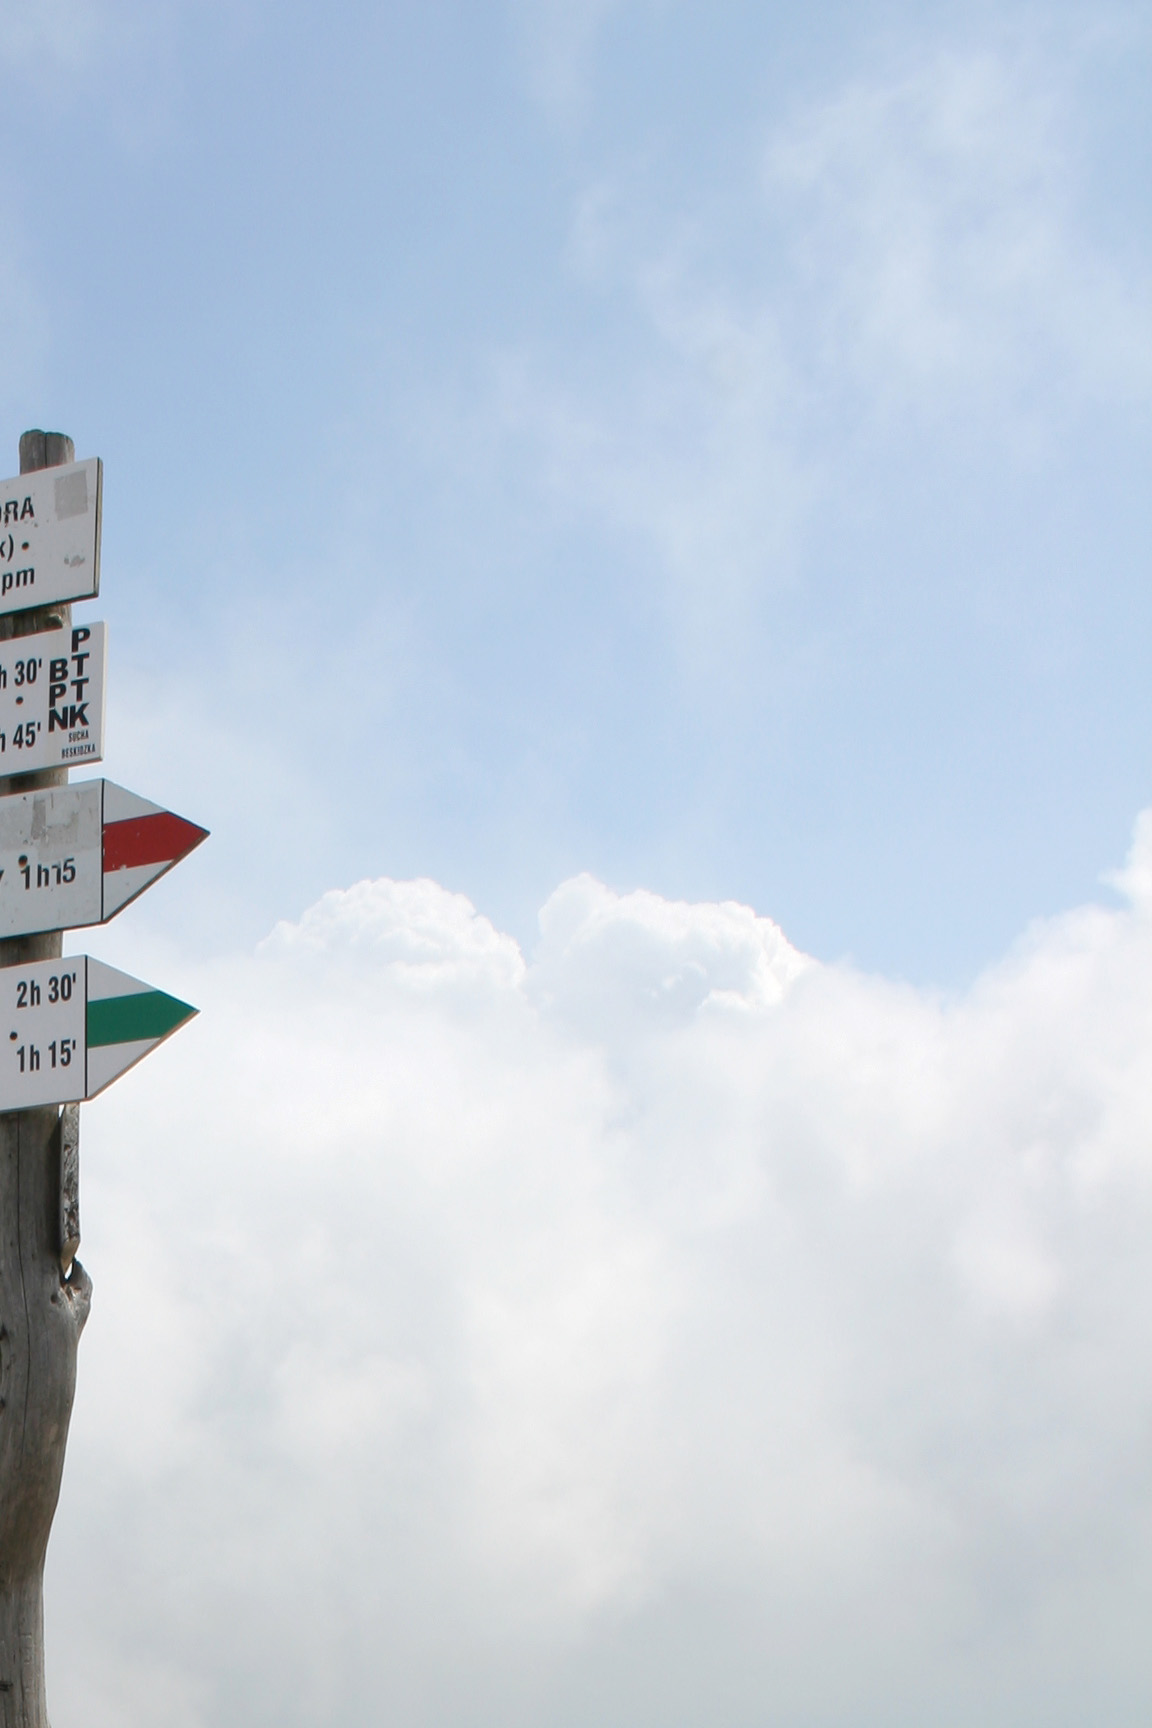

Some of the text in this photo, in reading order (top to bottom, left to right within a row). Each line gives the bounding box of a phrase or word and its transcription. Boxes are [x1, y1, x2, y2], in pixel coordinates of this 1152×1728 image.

[14, 658, 43, 686] 30'
[13, 721, 42, 749] 45'
[68, 730, 90, 743] SUCHA
[61, 744, 96, 759] BESKIDZKA
[16, 972, 77, 1009] 2h 30'
[16, 1039, 77, 1073] 1h 15'
